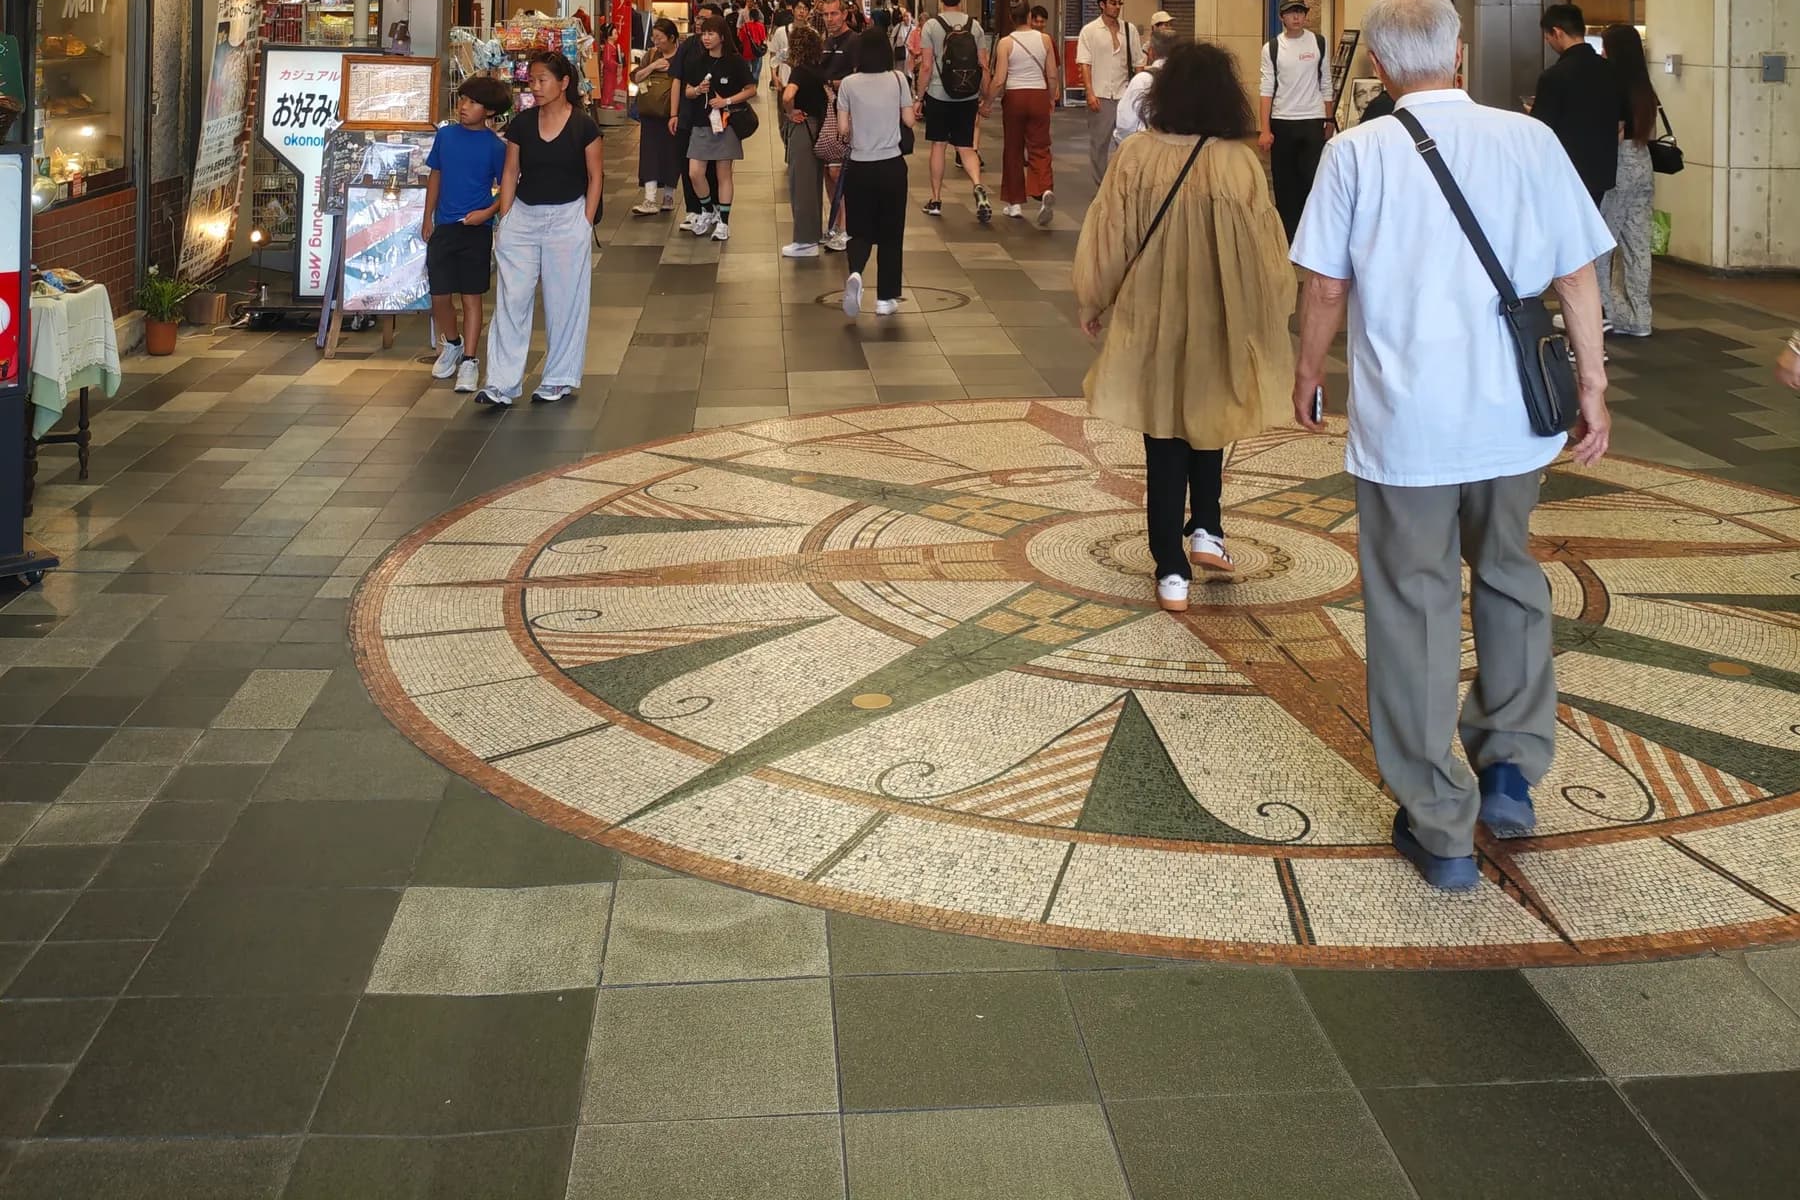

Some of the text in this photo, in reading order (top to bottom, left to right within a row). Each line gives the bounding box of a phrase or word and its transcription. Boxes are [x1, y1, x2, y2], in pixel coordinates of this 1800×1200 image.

[279, 69, 340, 81] カジュアル
[308, 252, 322, 289] Men
